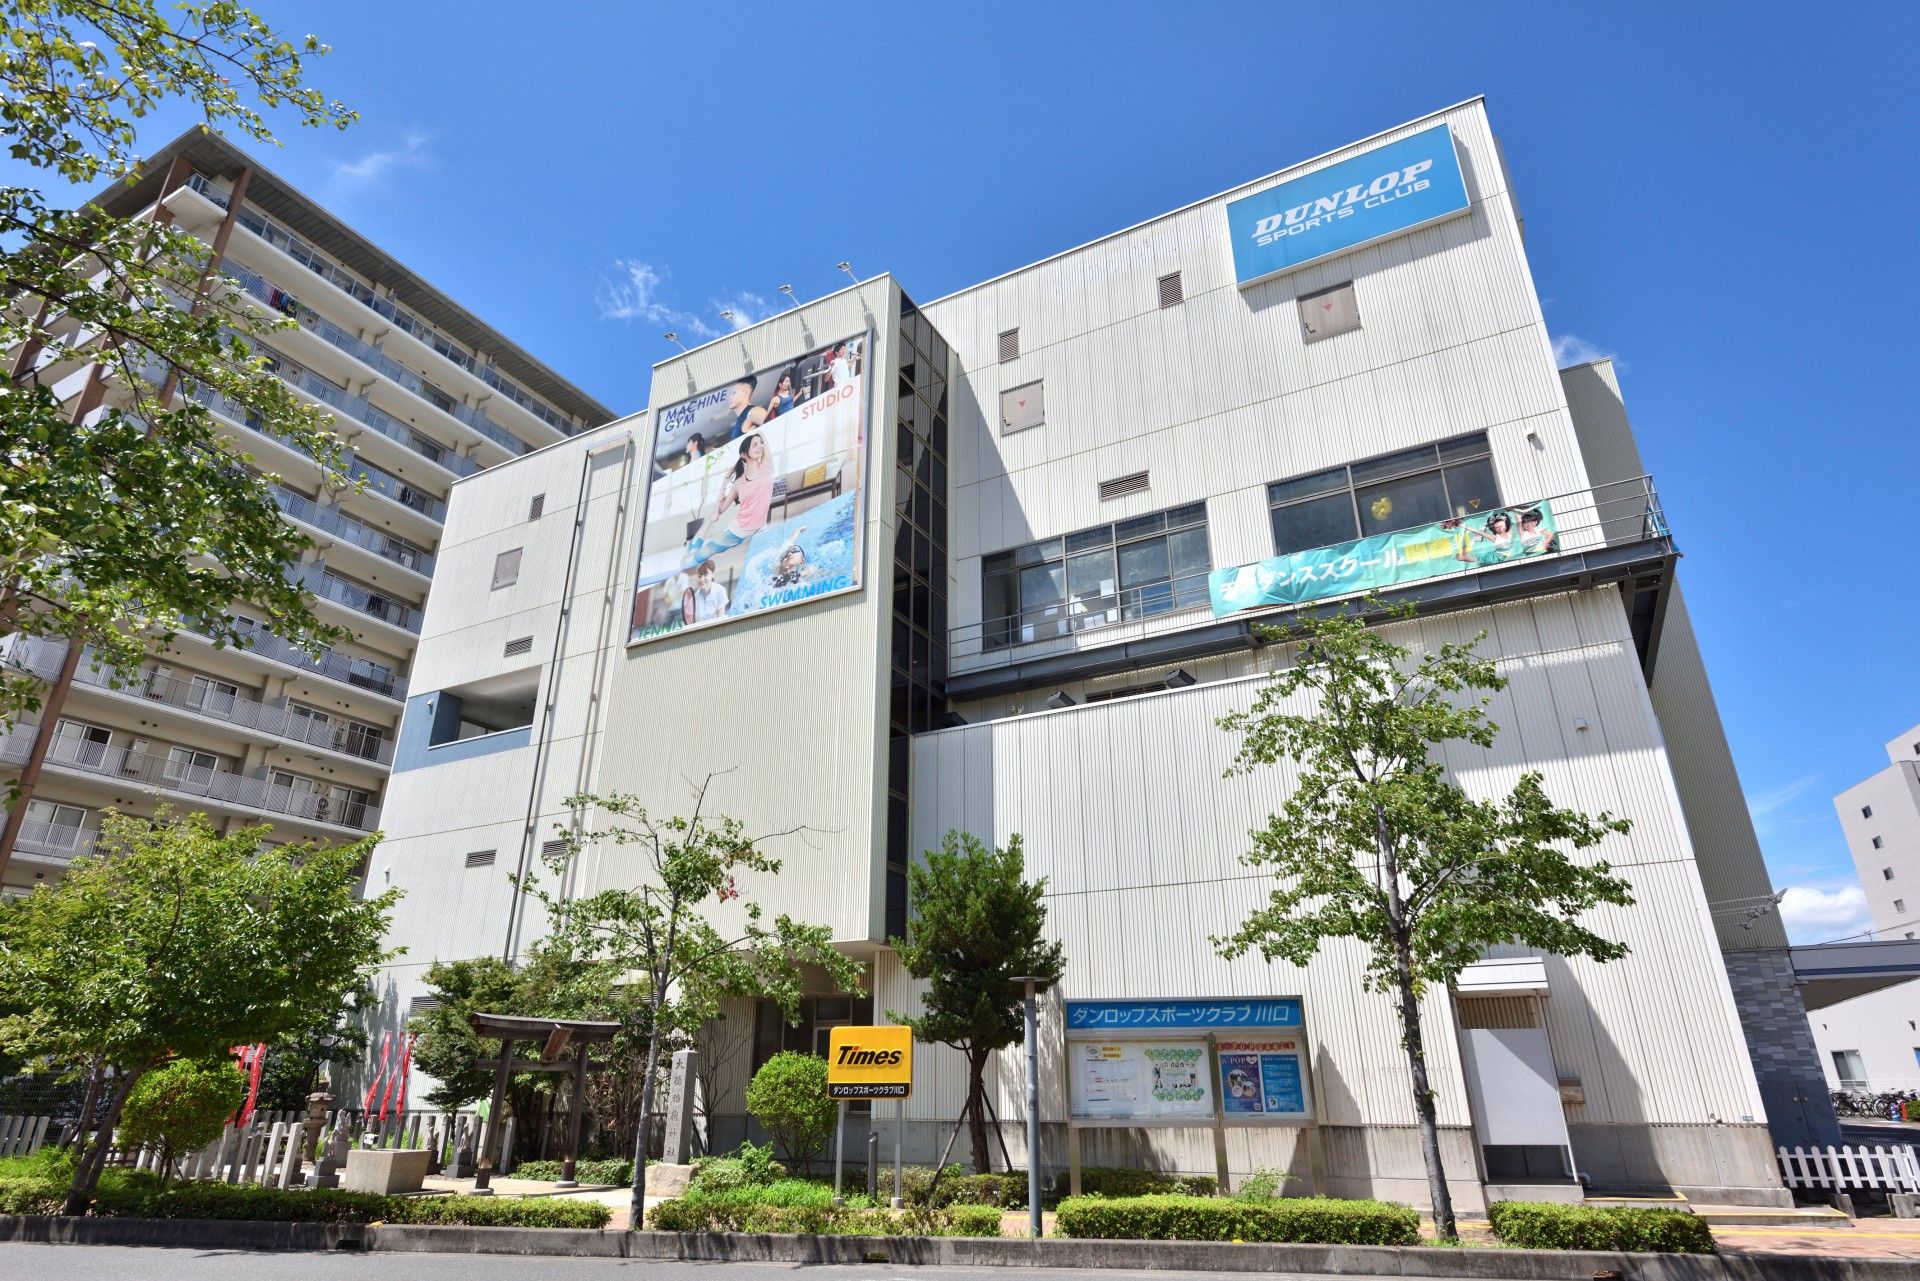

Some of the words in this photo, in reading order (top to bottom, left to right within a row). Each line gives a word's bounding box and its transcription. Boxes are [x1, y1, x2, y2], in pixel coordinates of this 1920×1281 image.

[1251, 159, 1433, 239] DUNLOP
[1257, 207, 1354, 247] SPORTS
[1365, 179, 1431, 209] CLUB
[665, 389, 729, 422] MACHINE
[801, 385, 854, 420] STUDIO
[664, 412, 696, 433] GYM
[760, 575, 848, 610] SWIMMING
[637, 618, 684, 640] TENNIS
[837, 1045, 903, 1066] Times
[833, 1085, 906, 1095] ダンロップスポーツクラブ川口
